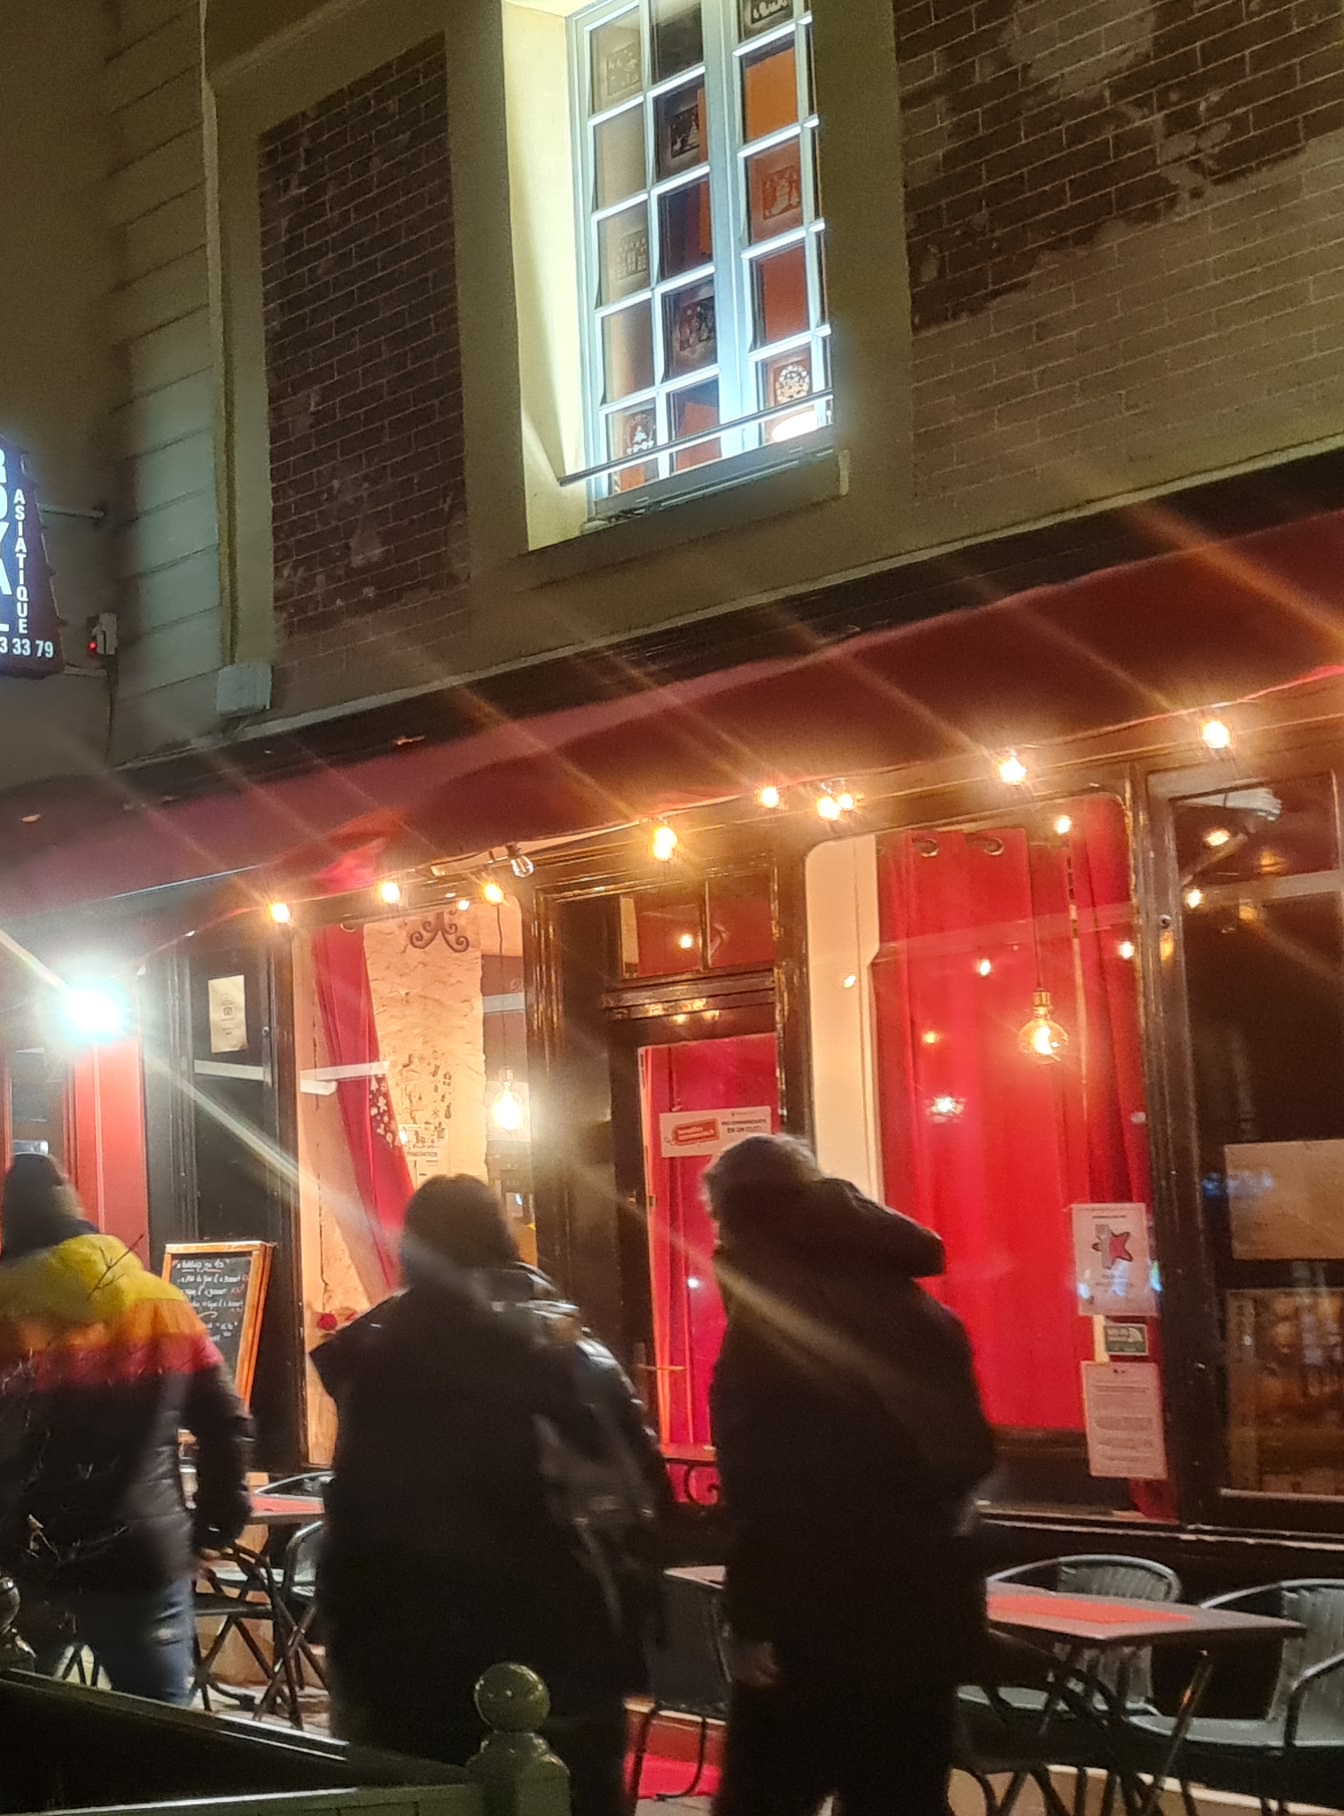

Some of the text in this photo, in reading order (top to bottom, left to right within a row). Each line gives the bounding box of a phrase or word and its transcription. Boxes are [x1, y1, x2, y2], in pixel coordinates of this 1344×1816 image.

[13, 488, 30, 635] ASIATIQUE
[12, 638, 32, 656] 33
[35, 640, 55, 659] 79
